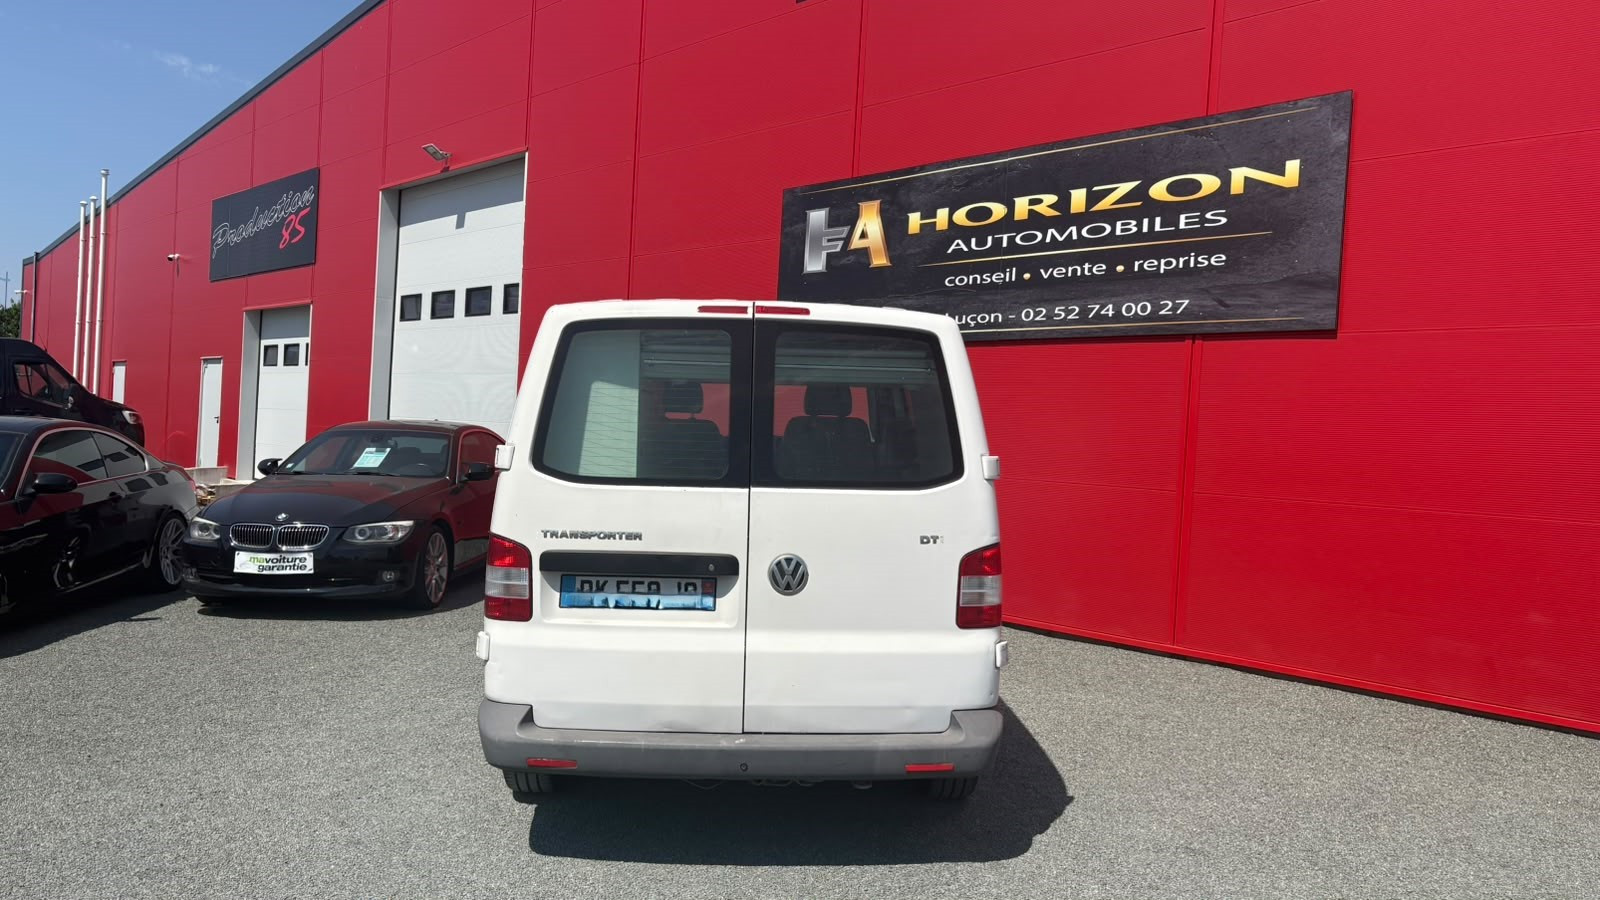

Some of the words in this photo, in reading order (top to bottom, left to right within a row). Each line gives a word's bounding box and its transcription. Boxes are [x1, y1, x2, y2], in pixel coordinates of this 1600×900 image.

[907, 158, 1300, 235] HORIZON
[212, 185, 315, 260] Production
[279, 206, 311, 249] 85
[946, 209, 1228, 254] AUTOMOBILES
[944, 267, 1016, 287] conseil
[1040, 262, 1107, 279] vente
[1133, 252, 1227, 273] reprise
[944, 312, 1003, 327] uçon
[1021, 307, 1047, 321] 02
[1053, 305, 1080, 320] 52
[1087, 303, 1115, 318] 74
[1121, 301, 1151, 316] 00
[1158, 300, 1190, 315] 27
[541, 529, 643, 541] TRANSPORTER
[249, 555, 308, 565] mavoiture
[257, 563, 308, 572] garantie
